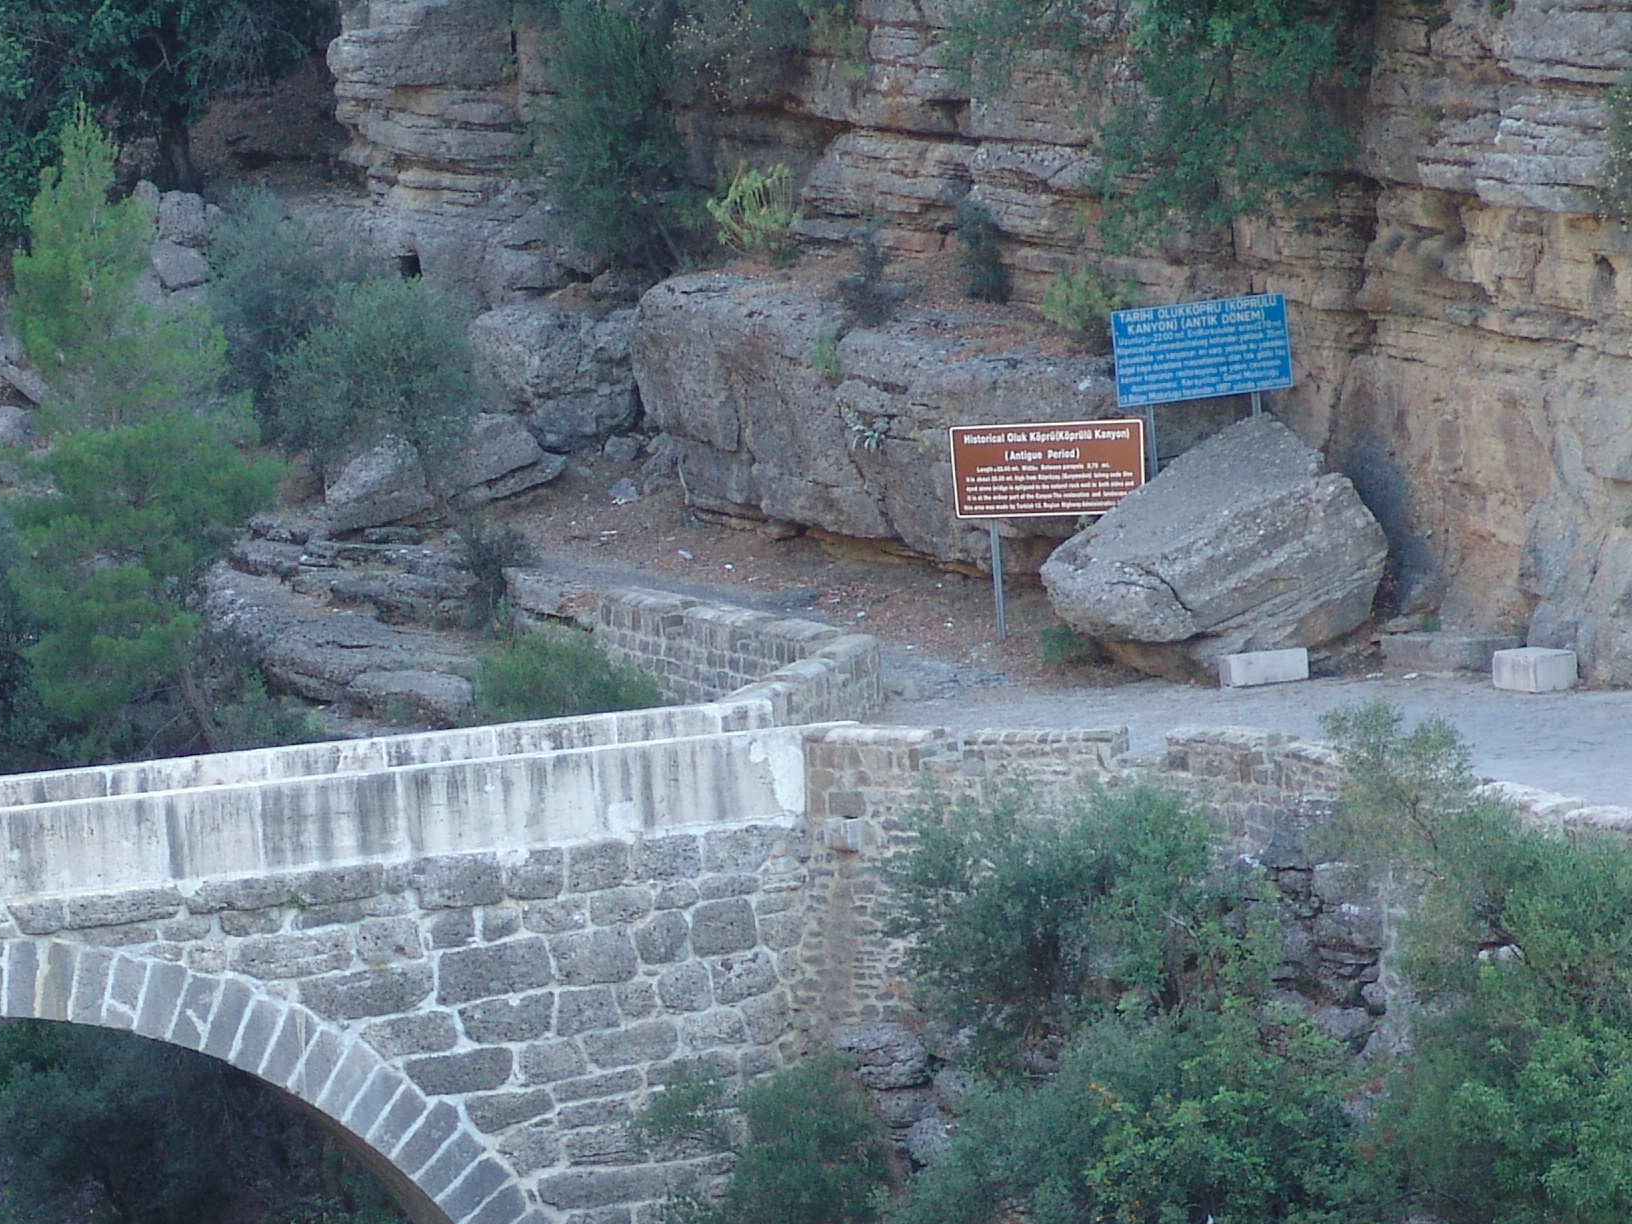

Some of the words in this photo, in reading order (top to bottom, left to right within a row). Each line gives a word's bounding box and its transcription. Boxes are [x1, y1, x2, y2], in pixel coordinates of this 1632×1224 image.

[1127, 320, 1178, 335] KANYON)
[963, 432, 1005, 444] Historical
[1007, 431, 1028, 443] Oluk
[1094, 427, 1130, 441] Kanyon)
